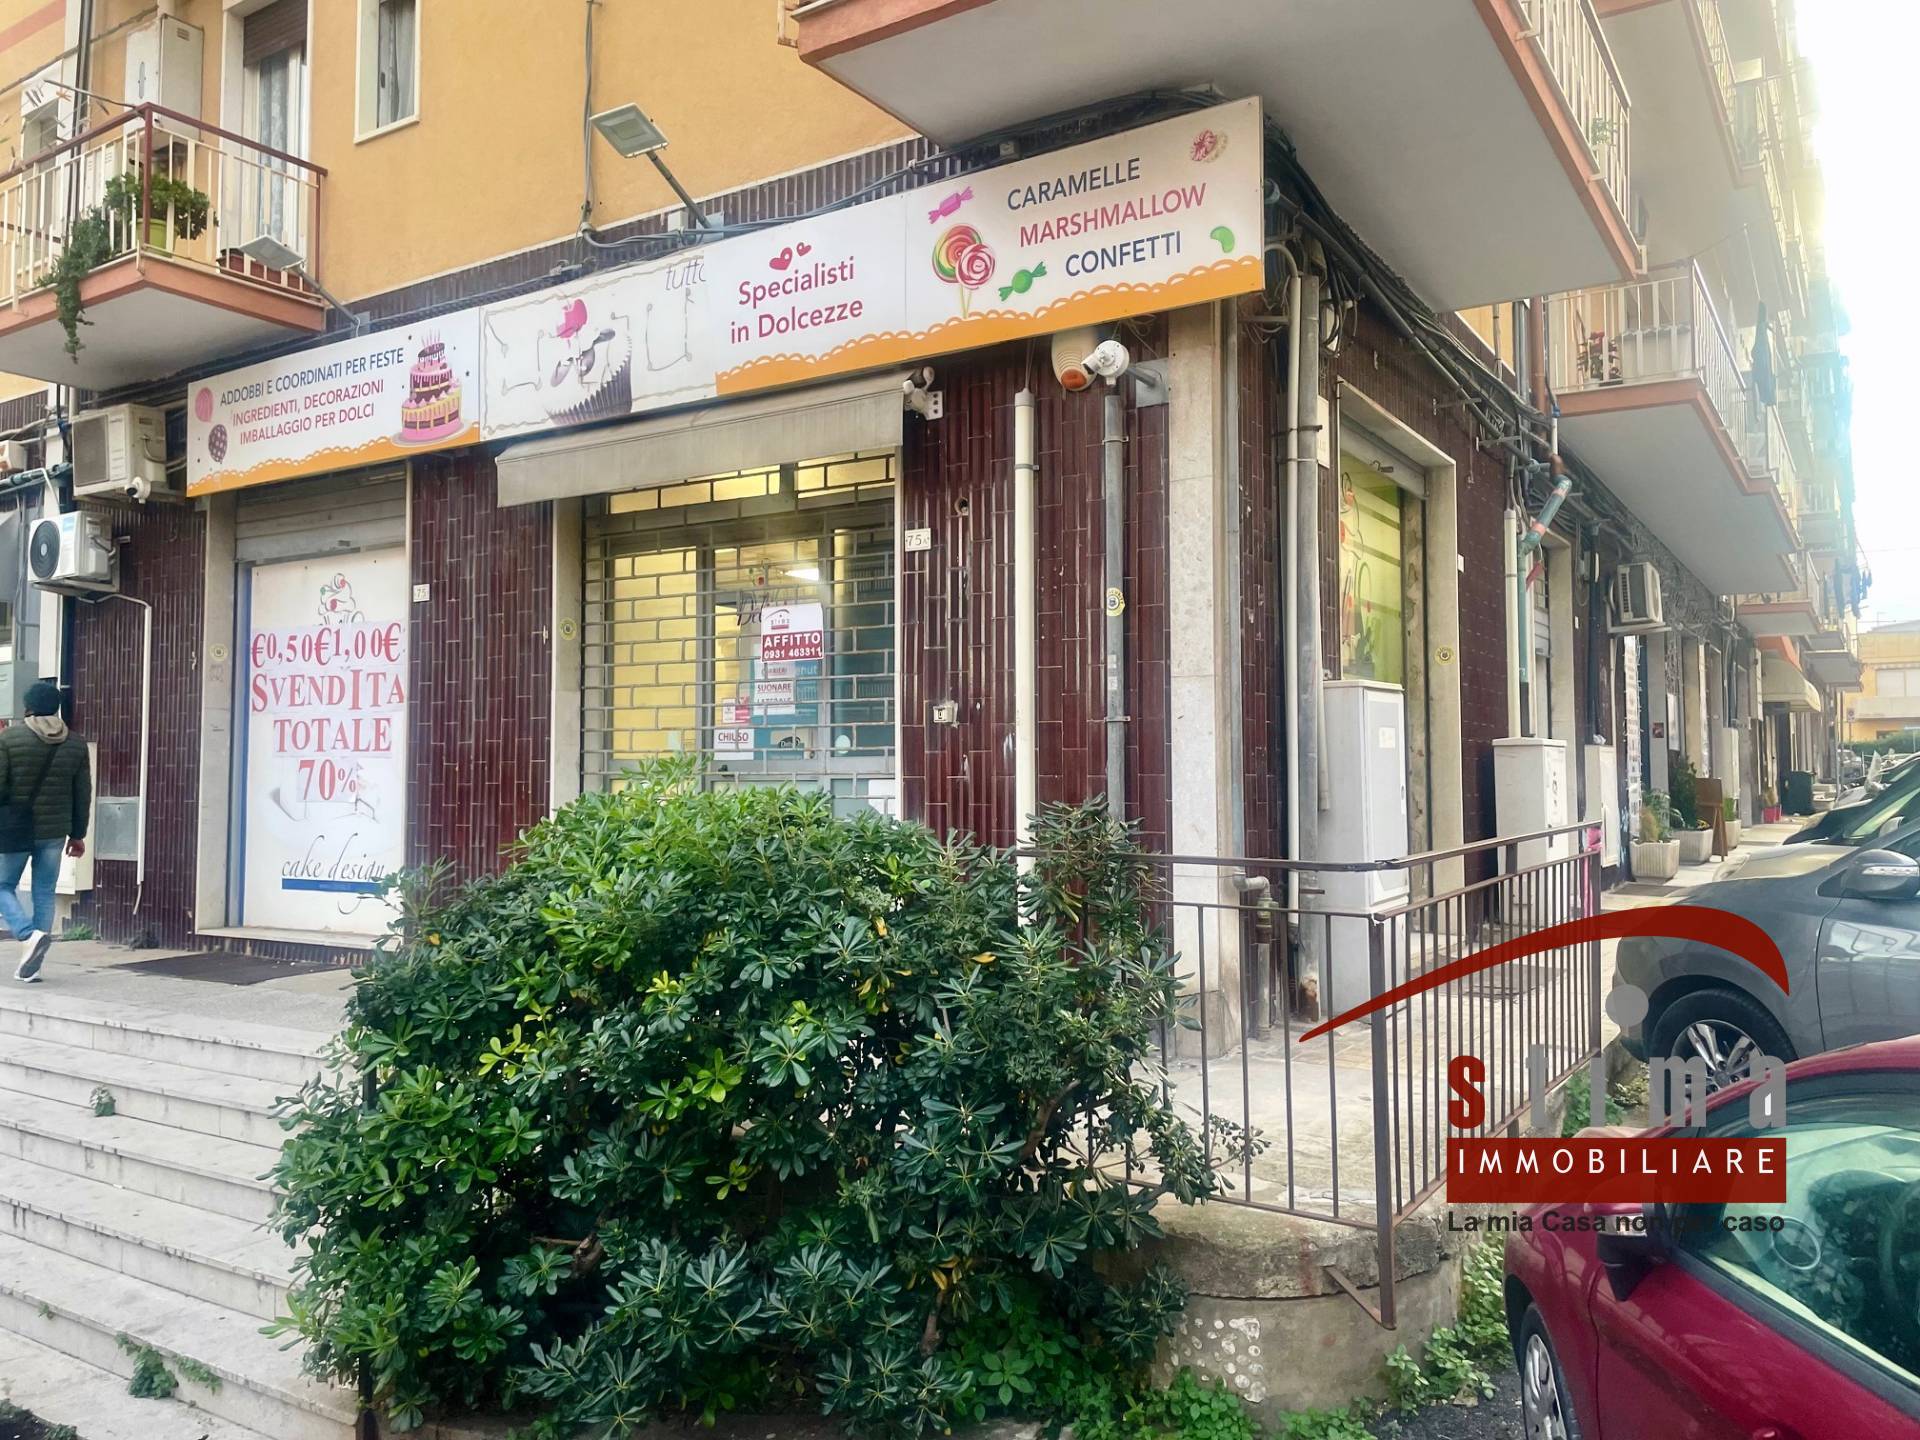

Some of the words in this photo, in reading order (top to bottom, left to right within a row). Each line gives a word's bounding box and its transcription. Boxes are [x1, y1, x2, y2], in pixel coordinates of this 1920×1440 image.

[1007, 157, 1141, 210] CARAMELLE
[1019, 182, 1207, 248] MARSHMALLOW
[1065, 230, 1182, 277] CONFETTI
[738, 256, 855, 310] Specialisti
[731, 321, 750, 344] in
[758, 299, 864, 338] Dolcezze
[219, 382, 265, 407] ADDOBBI
[266, 379, 274, 393] E
[275, 362, 343, 392] COORDINATI
[345, 356, 367, 378] PER
[369, 347, 404, 370] FESTE
[232, 401, 301, 426] INGREDIENTI,
[304, 379, 384, 411] DECORAZIONI
[239, 417, 312, 445] IMBALLAGGIO
[314, 412, 336, 429] PER
[339, 403, 375, 423] DOLCI
[764, 632, 821, 649] AFFITTO
[251, 669, 405, 712] SVENDITA
[273, 717, 392, 753] TOTALE
[298, 758, 357, 801] 70%
[281, 834, 325, 878] cake
